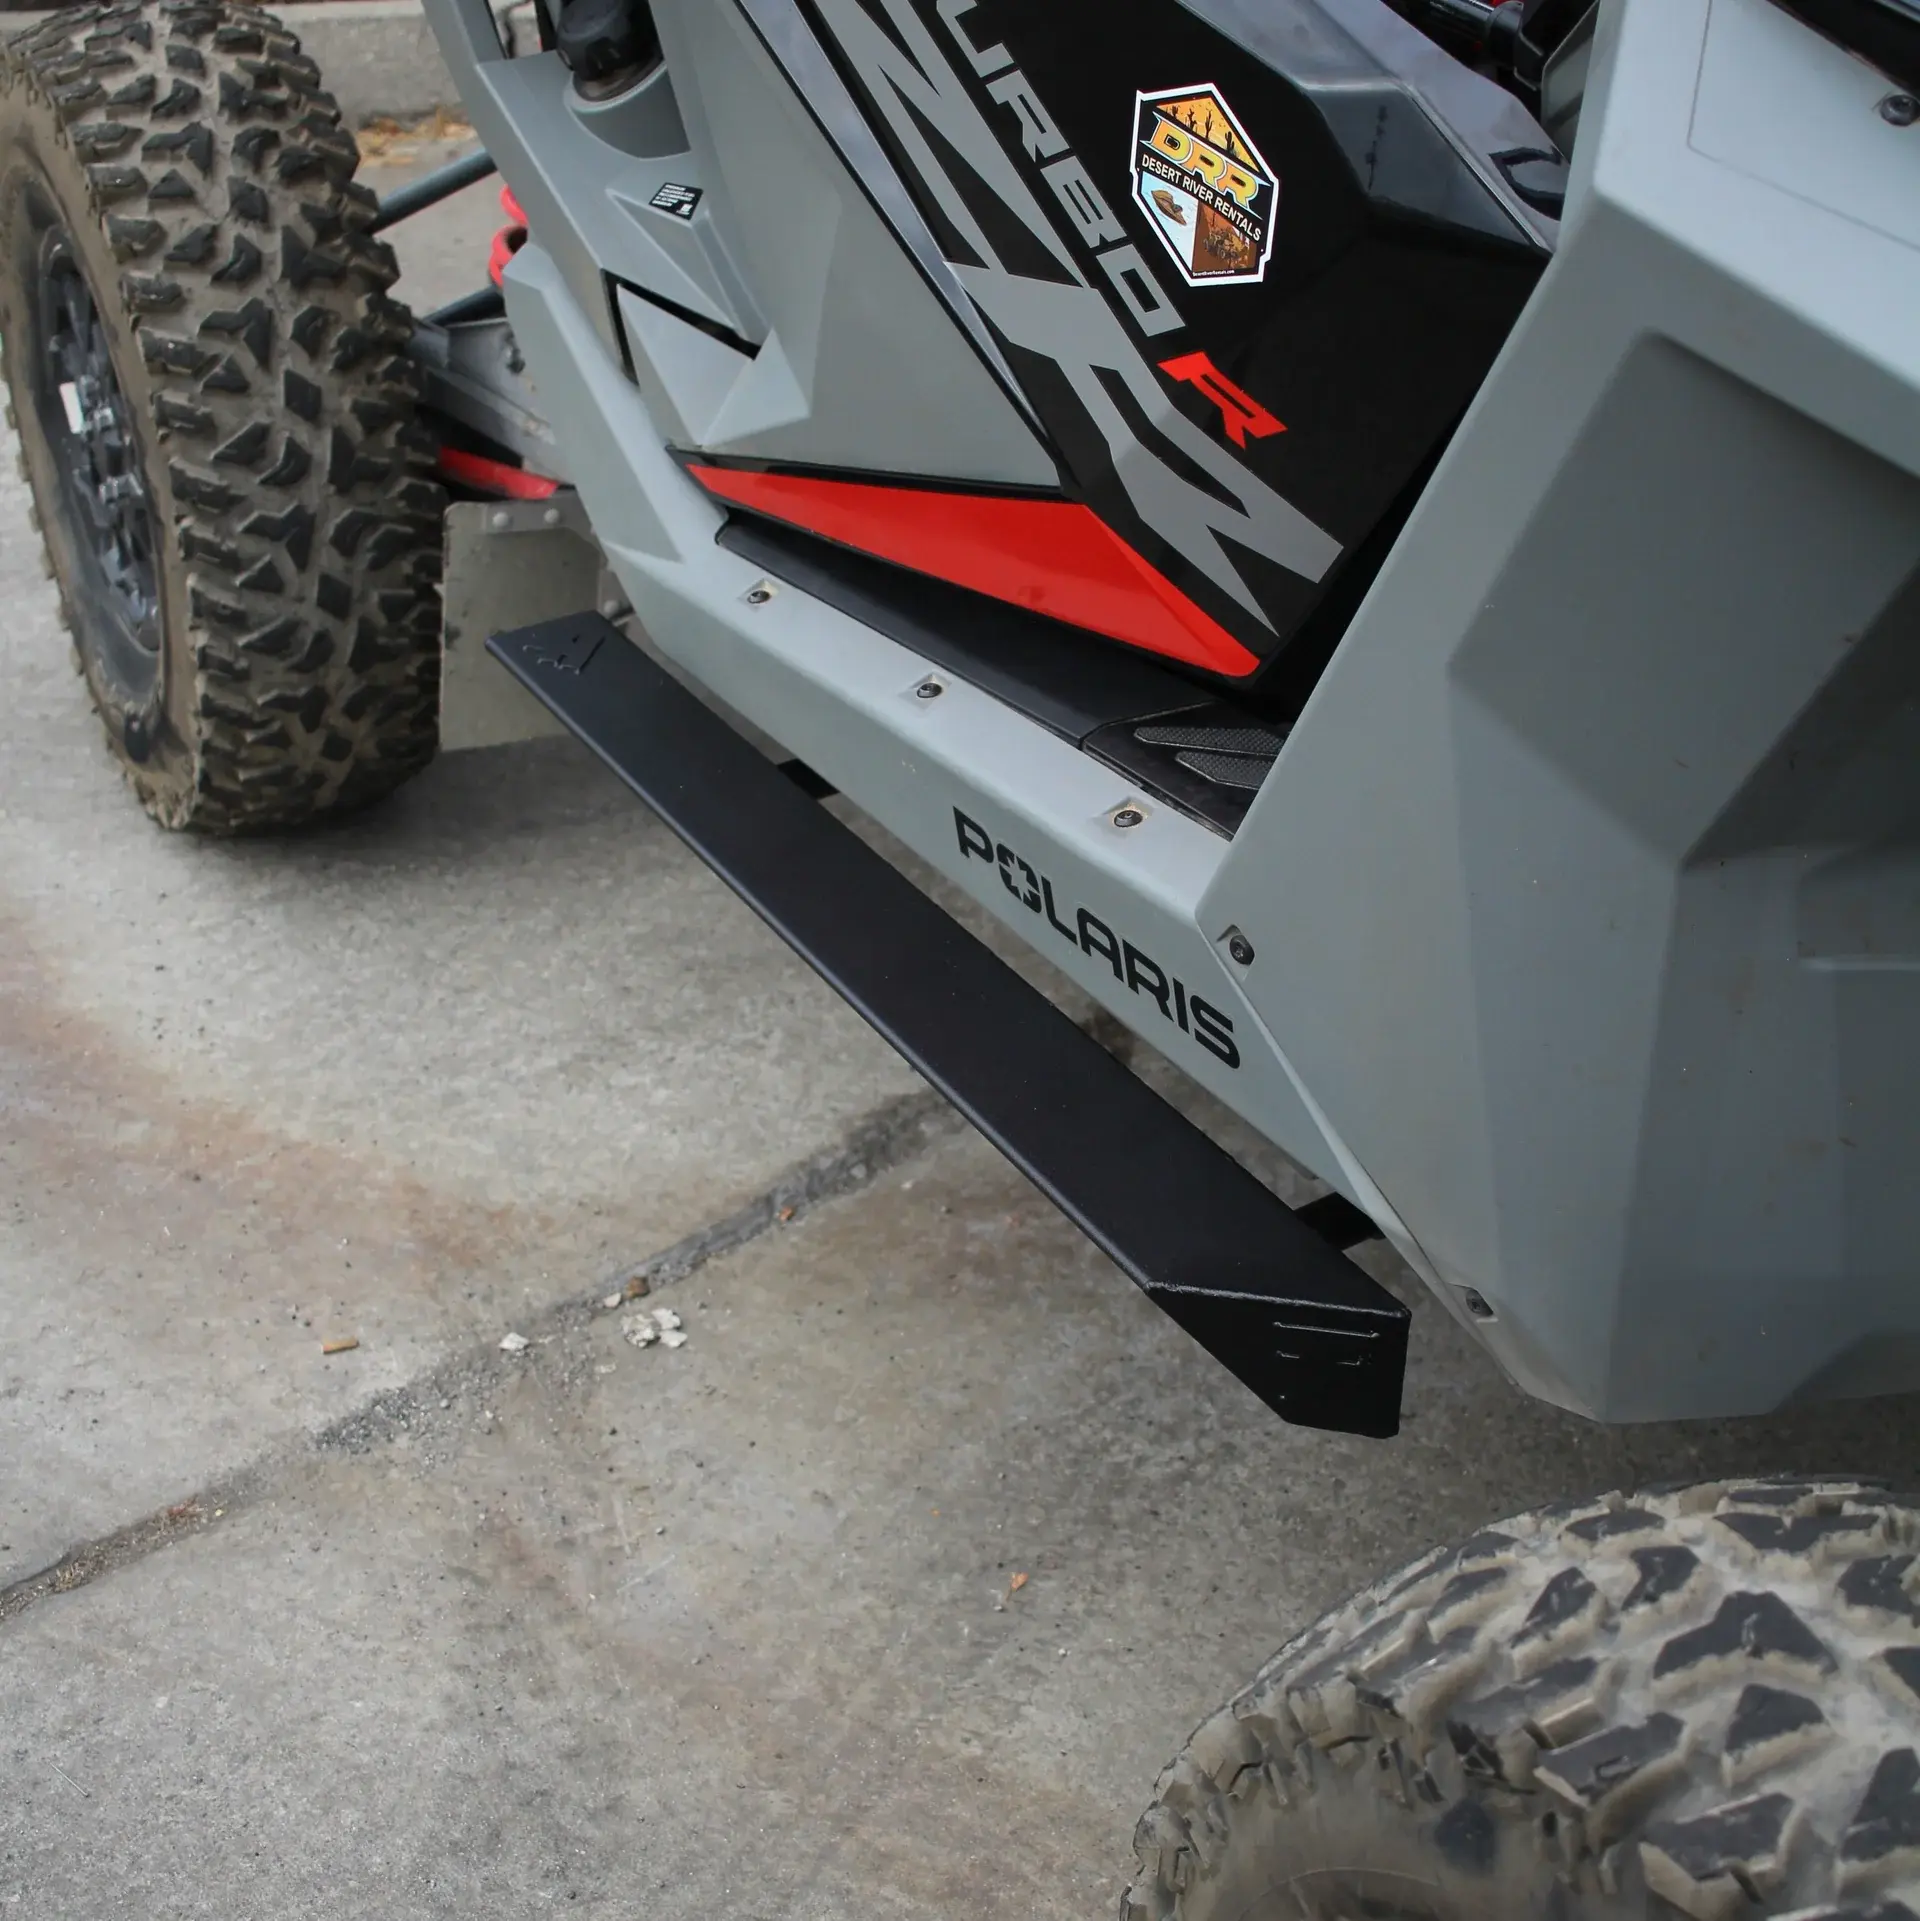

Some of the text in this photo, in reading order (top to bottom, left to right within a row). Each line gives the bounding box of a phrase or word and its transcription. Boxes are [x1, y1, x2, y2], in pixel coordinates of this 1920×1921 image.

[1141, 153, 1262, 242] DESERT RIVER RENTALS
[1149, 118, 1259, 209] DRR
[1156, 350, 1288, 450] R
[952, 805, 1241, 1070] POLARIS
